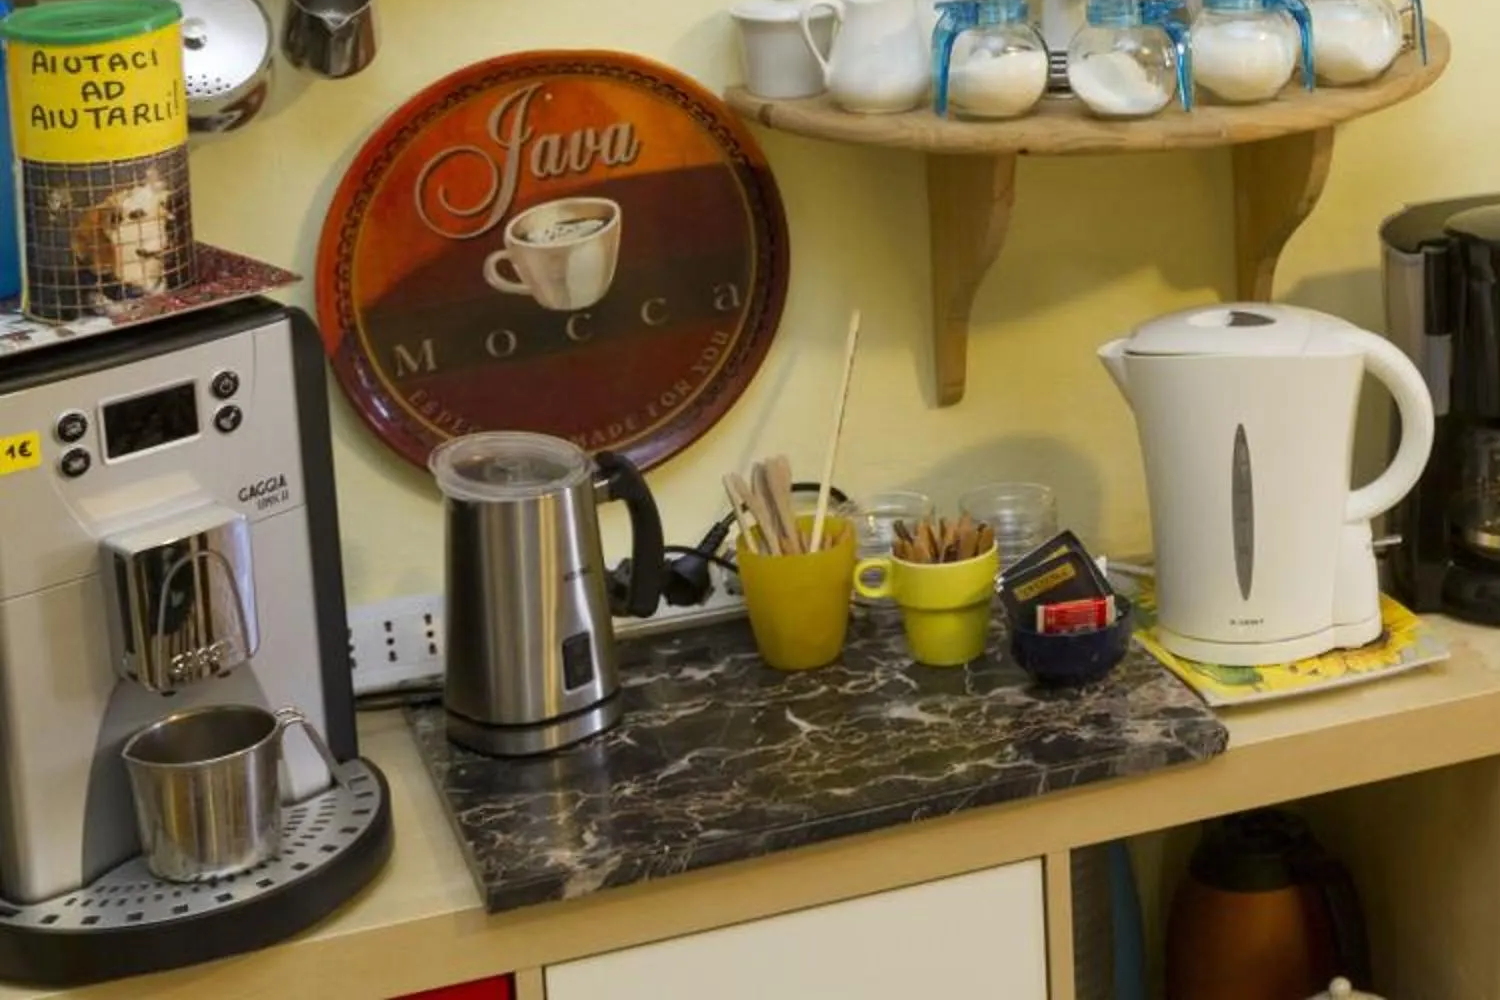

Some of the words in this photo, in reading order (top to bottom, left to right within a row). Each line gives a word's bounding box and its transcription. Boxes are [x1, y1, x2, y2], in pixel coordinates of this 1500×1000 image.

[31, 48, 158, 75] AIUTACI
[81, 80, 125, 102] AD
[415, 82, 642, 239] Java
[4, 440, 33, 460] 1€
